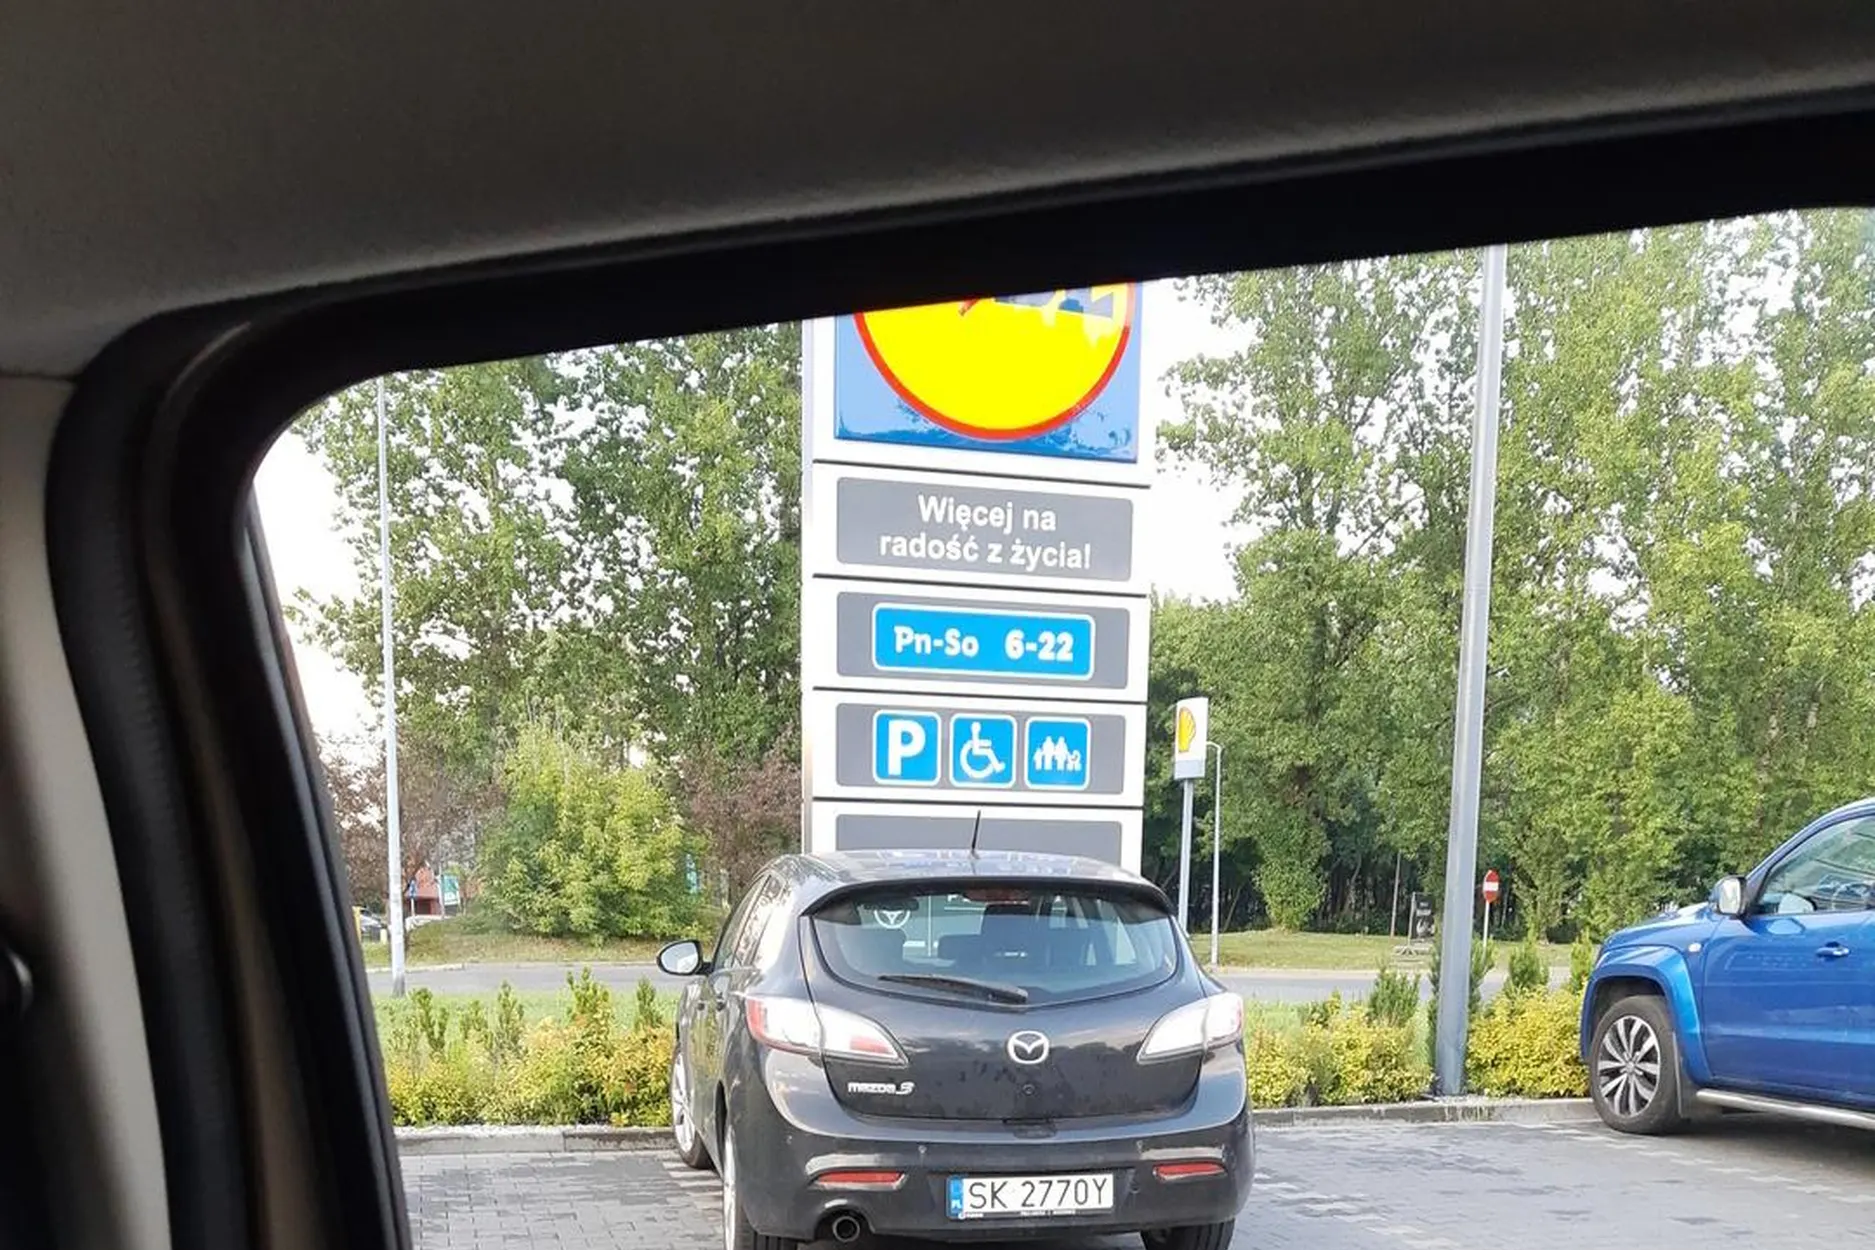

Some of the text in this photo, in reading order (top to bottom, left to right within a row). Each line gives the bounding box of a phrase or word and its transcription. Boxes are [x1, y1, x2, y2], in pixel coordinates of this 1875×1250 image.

[917, 494, 1057, 533] Więcej na
[879, 532, 1092, 573] radość z życia!
[893, 624, 1075, 662] Pn-So 6-22
[887, 718, 927, 777] P
[968, 1177, 1108, 1209] SK 2770Y
